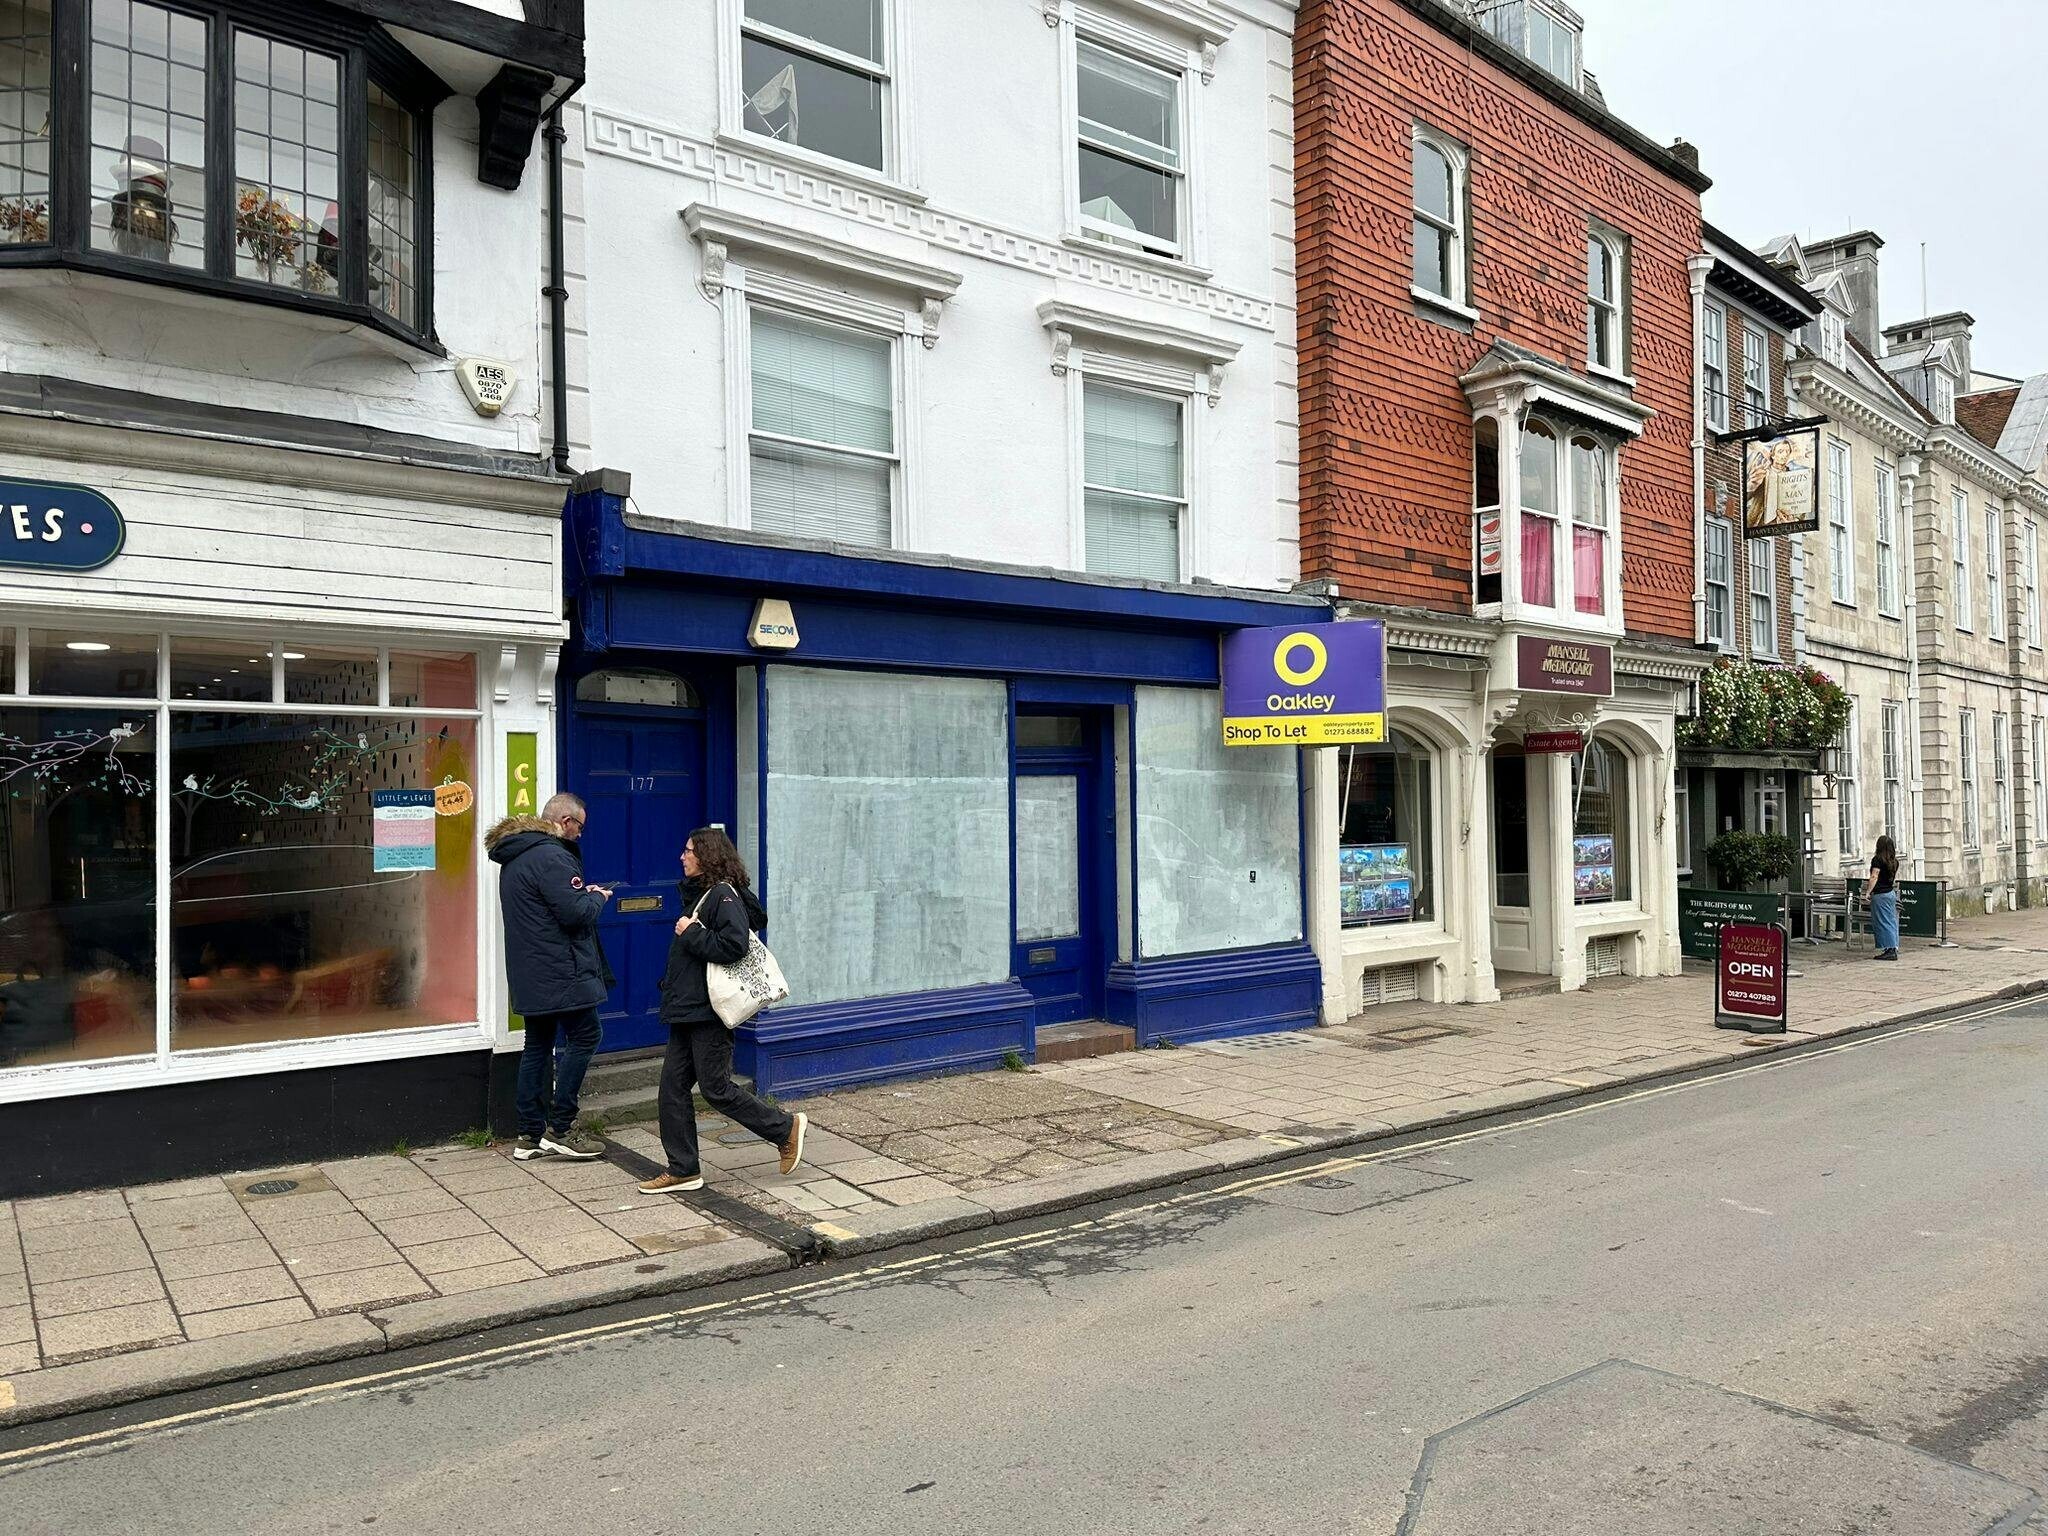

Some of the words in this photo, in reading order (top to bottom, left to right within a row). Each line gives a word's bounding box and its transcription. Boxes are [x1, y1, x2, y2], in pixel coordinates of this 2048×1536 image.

[477, 367, 503, 380] AES
[477, 380, 502, 389] 0870
[479, 392, 502, 401] 1468
[0, 504, 64, 542] ES
[760, 624, 794, 635] SECOM
[1547, 644, 1590, 662] MANSELL
[1542, 658, 1594, 676] McTAGGART
[1266, 692, 1336, 712] Oakley
[1226, 726, 1261, 741] Shop
[1264, 725, 1281, 738] To
[1284, 724, 1307, 737] Let
[1528, 739, 1551, 748] Estate
[1552, 739, 1578, 748] Agents
[513, 762, 531, 816] CA
[631, 777, 654, 790] 177
[377, 794, 401, 802] LITTLE
[1703, 901, 1728, 909] RIGHTS
[1728, 902, 1737, 910] OF
[1730, 935, 1772, 946] MANSELL
[1728, 961, 1774, 978] OPEN
[1727, 990, 1748, 999] 01273
[1749, 992, 1776, 1002] 407929
